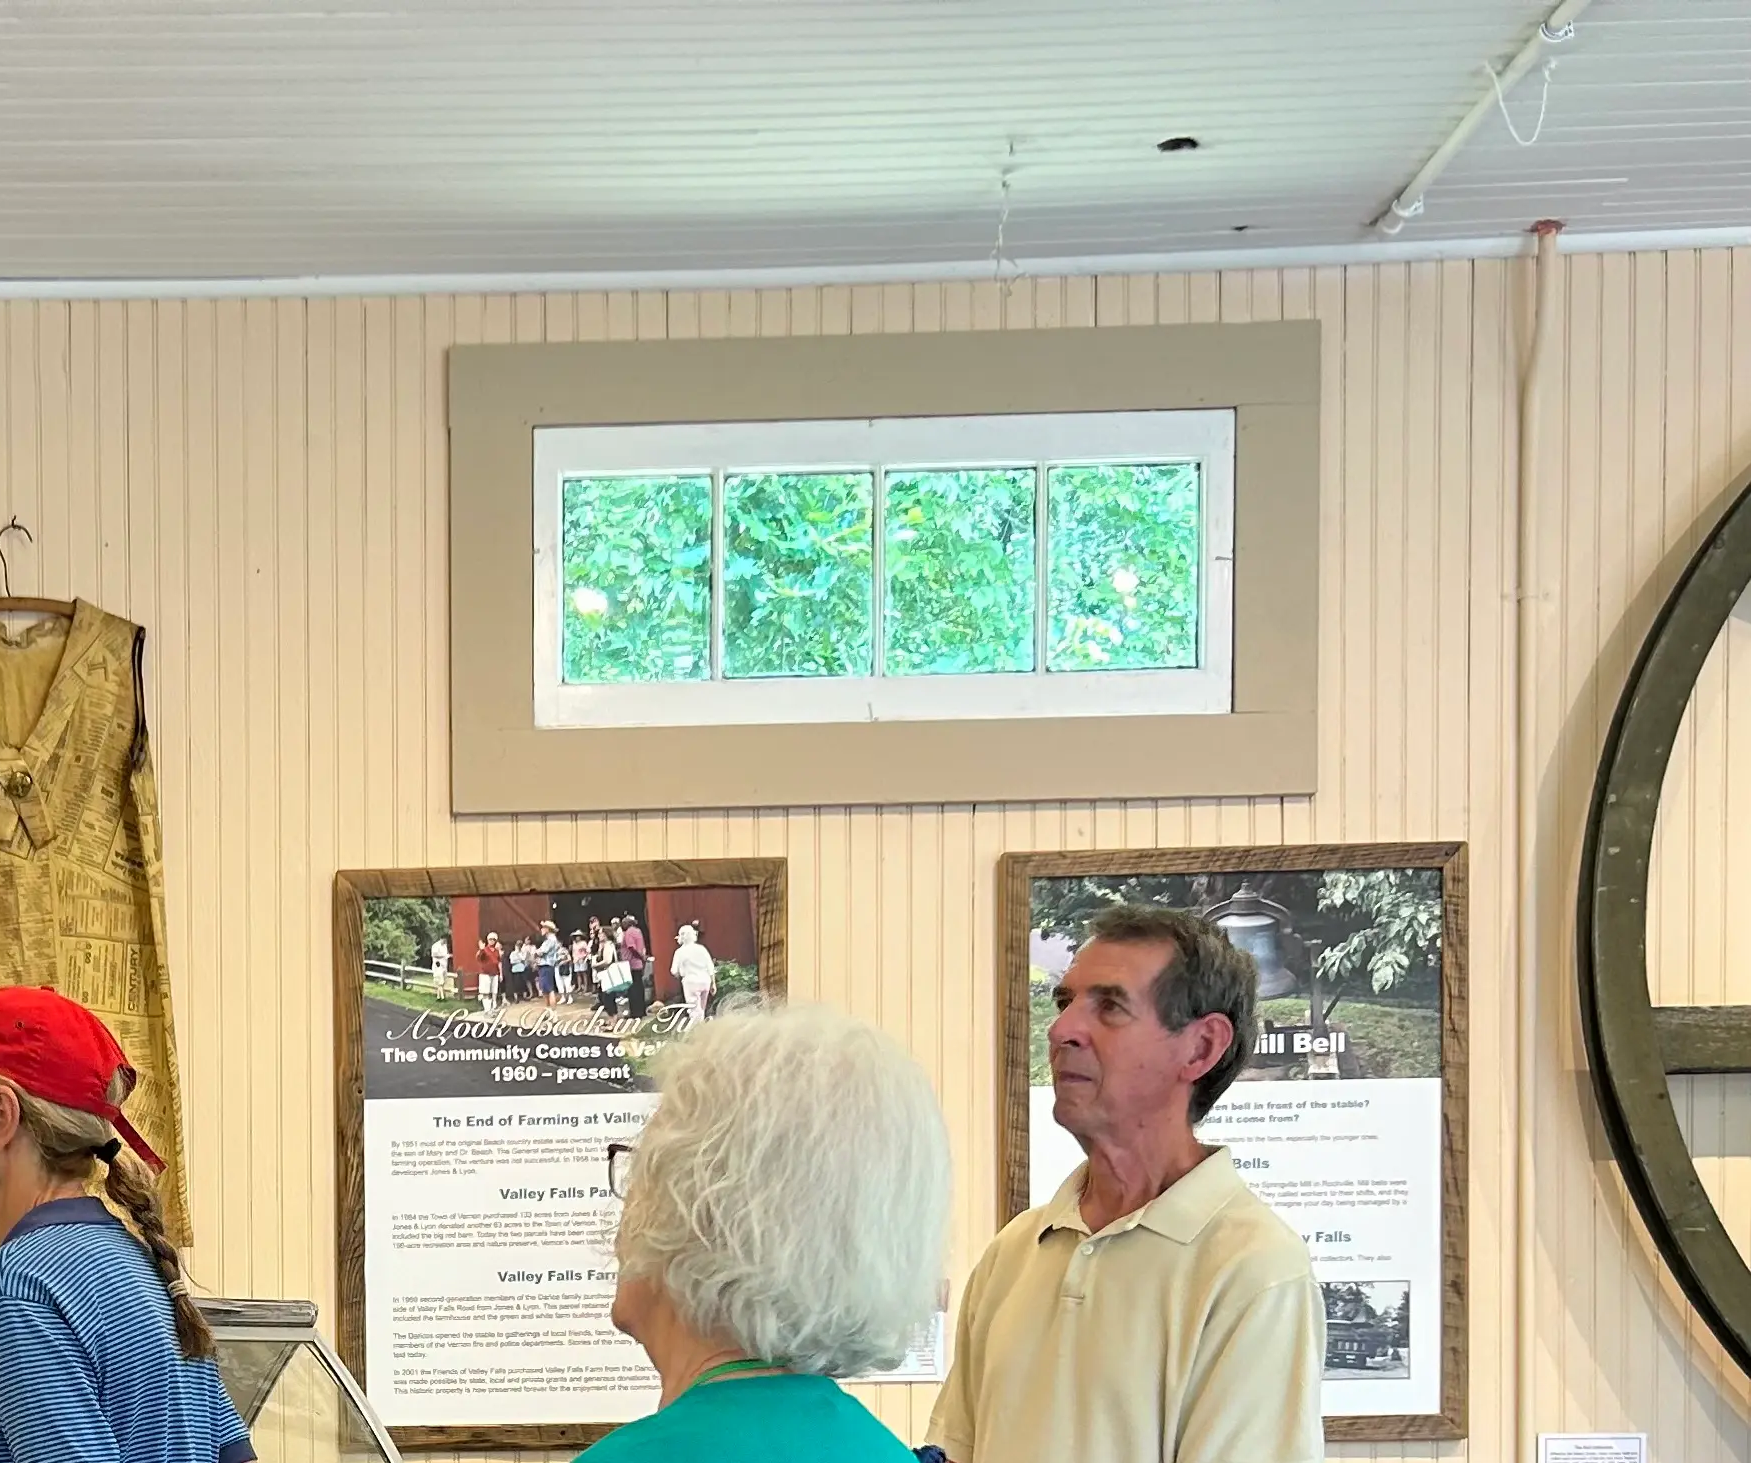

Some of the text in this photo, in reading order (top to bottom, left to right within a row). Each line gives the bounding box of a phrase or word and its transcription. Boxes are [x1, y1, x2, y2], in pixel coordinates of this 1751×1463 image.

[386, 1008, 429, 1041] A
[427, 1007, 508, 1045] Look
[517, 1005, 606, 1037] Back
[612, 1010, 643, 1034] in
[1293, 1032, 1345, 1053] Bell
[381, 1047, 418, 1063] The
[423, 1044, 531, 1065] Community
[535, 1043, 601, 1059] Comes
[606, 1043, 625, 1057] to
[491, 1066, 537, 1082] 1960
[556, 1064, 631, 1083] present
[1231, 1102, 1251, 1110] bell
[1254, 1102, 1264, 1110] in
[1267, 1101, 1293, 1110] front
[1296, 1101, 1308, 1109] of
[1311, 1101, 1327, 1109] the
[1331, 1100, 1370, 1109] stable?
[433, 1111, 648, 1129] The End of Farming at Valley
[1225, 1115, 1233, 1123] it
[1268, 1114, 1300, 1123] from?
[1232, 1158, 1270, 1169] Bells
[499, 1187, 616, 1202] Valley Falls Par
[1315, 1231, 1351, 1243] Falls
[497, 1271, 543, 1284] Valley
[548, 1270, 583, 1282] Falls
